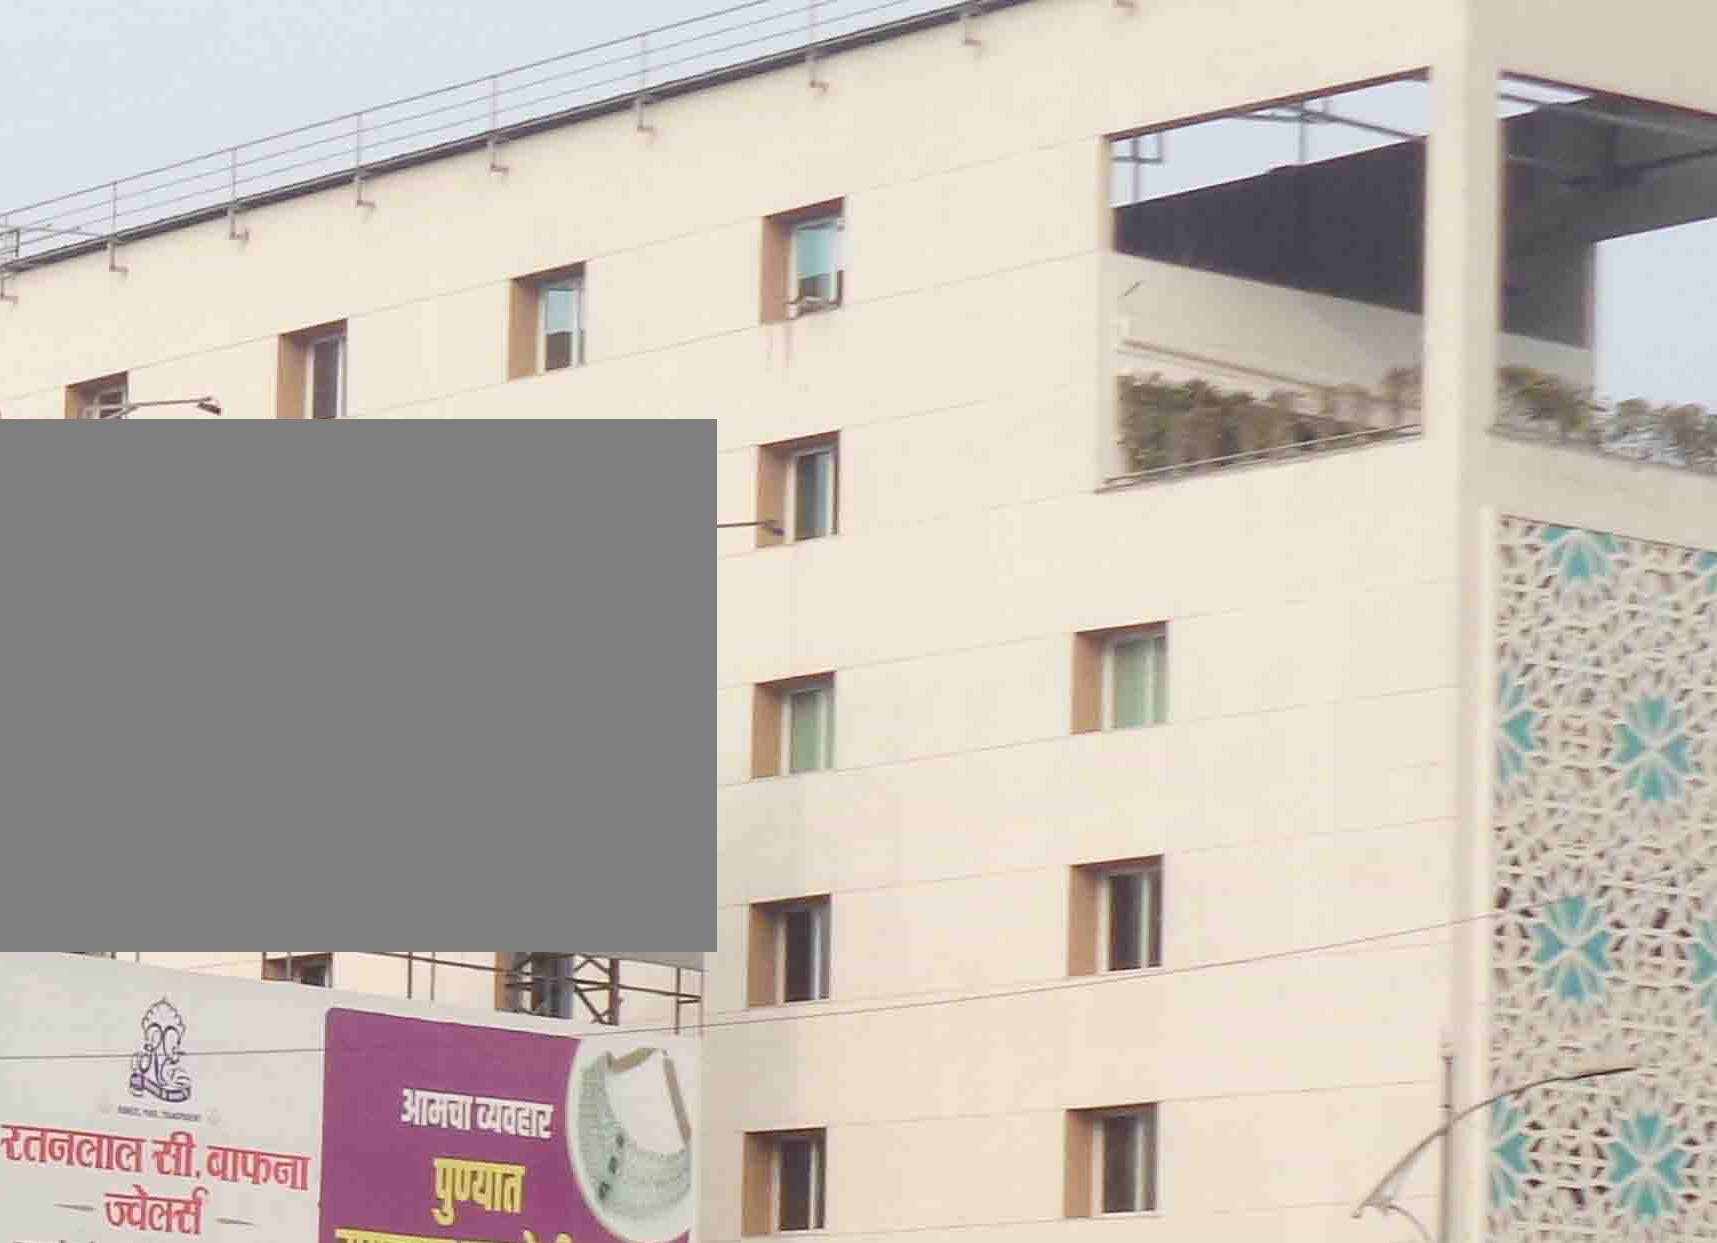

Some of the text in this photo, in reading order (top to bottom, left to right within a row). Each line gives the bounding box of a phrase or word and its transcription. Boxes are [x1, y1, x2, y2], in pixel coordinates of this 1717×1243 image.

[400, 1088, 555, 1139] आमचा व्यवहार
[0, 1123, 147, 1173] रतनलाल
[206, 1145, 312, 1191] बाफना
[104, 1183, 210, 1236] ज्वेलर्स
[432, 1157, 526, 1227] पुण्यात
